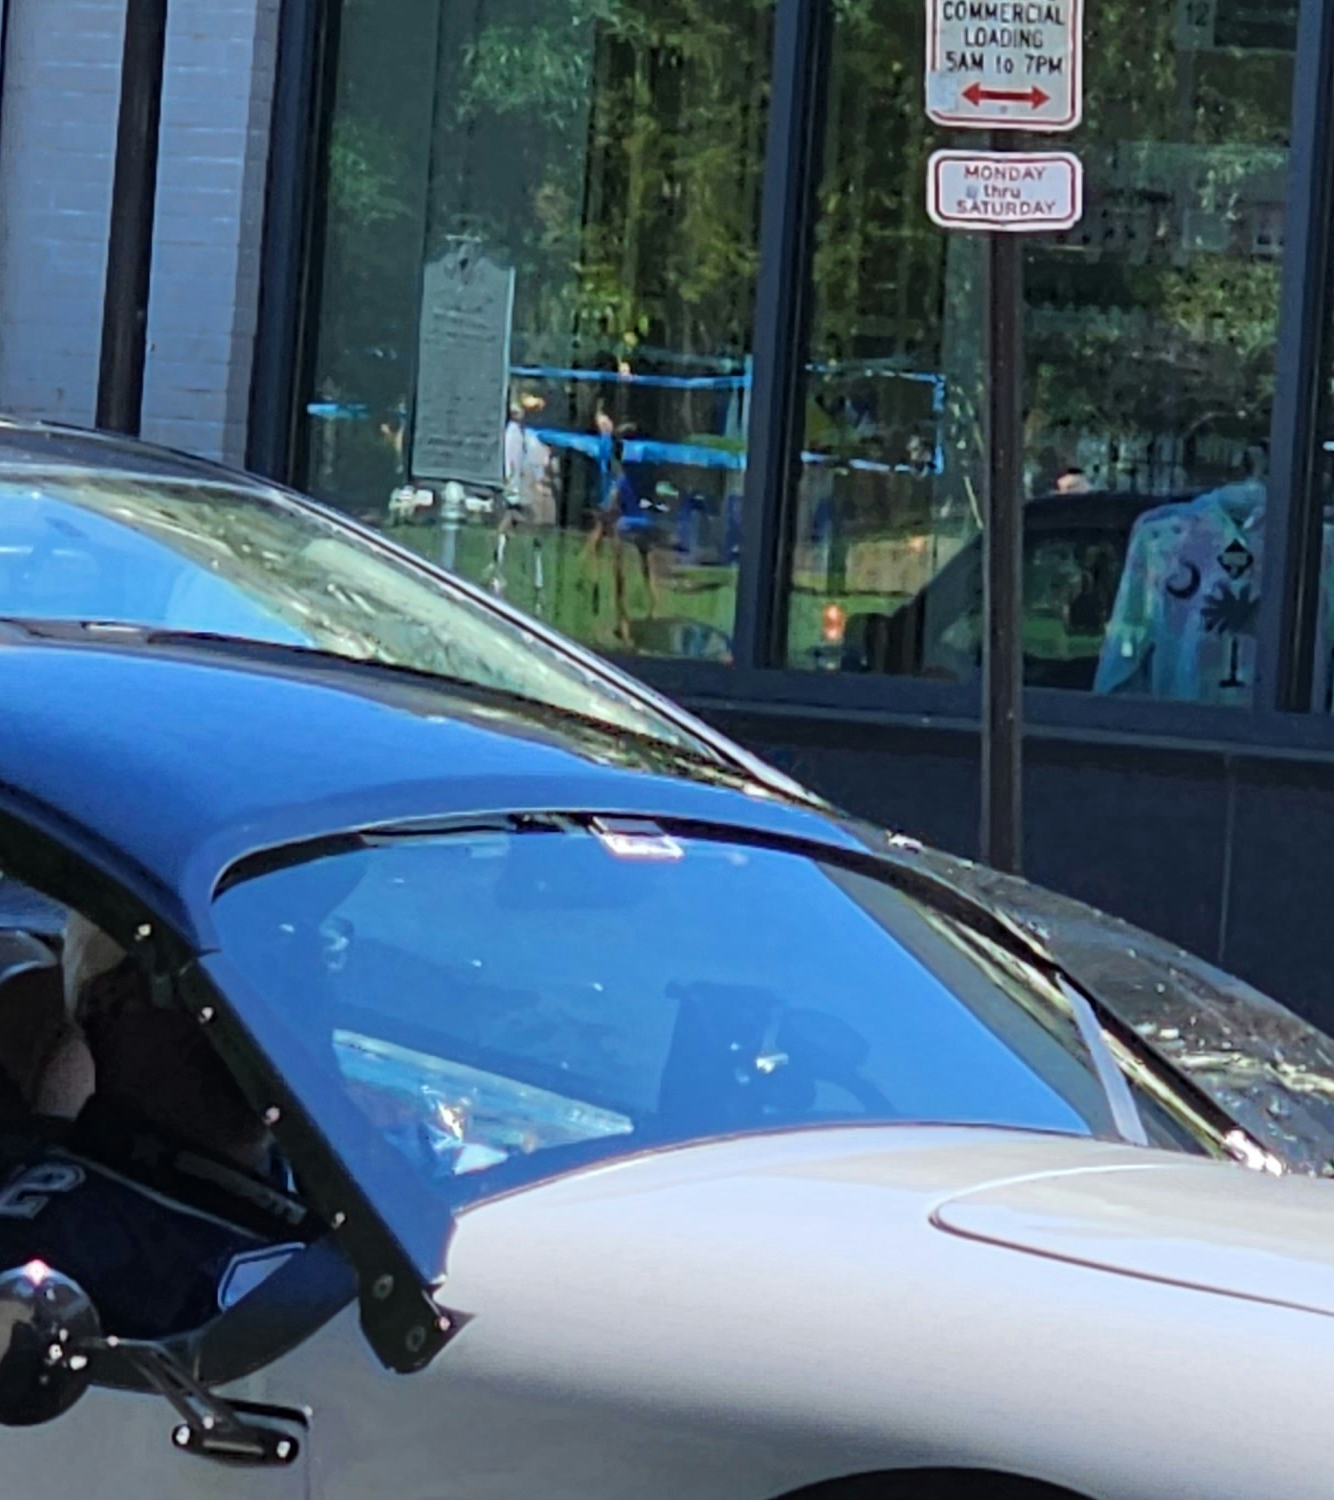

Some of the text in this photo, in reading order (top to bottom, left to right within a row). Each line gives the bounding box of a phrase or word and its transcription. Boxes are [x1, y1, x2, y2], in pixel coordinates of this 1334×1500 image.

[942, 0, 1065, 26] COMMERCIAL
[964, 27, 1044, 49] LOADING
[945, 51, 1063, 75] 5AM to 7PM
[964, 165, 1046, 183] MONDAY
[983, 184, 1022, 199] thru
[956, 200, 1056, 217] SATURDAY
